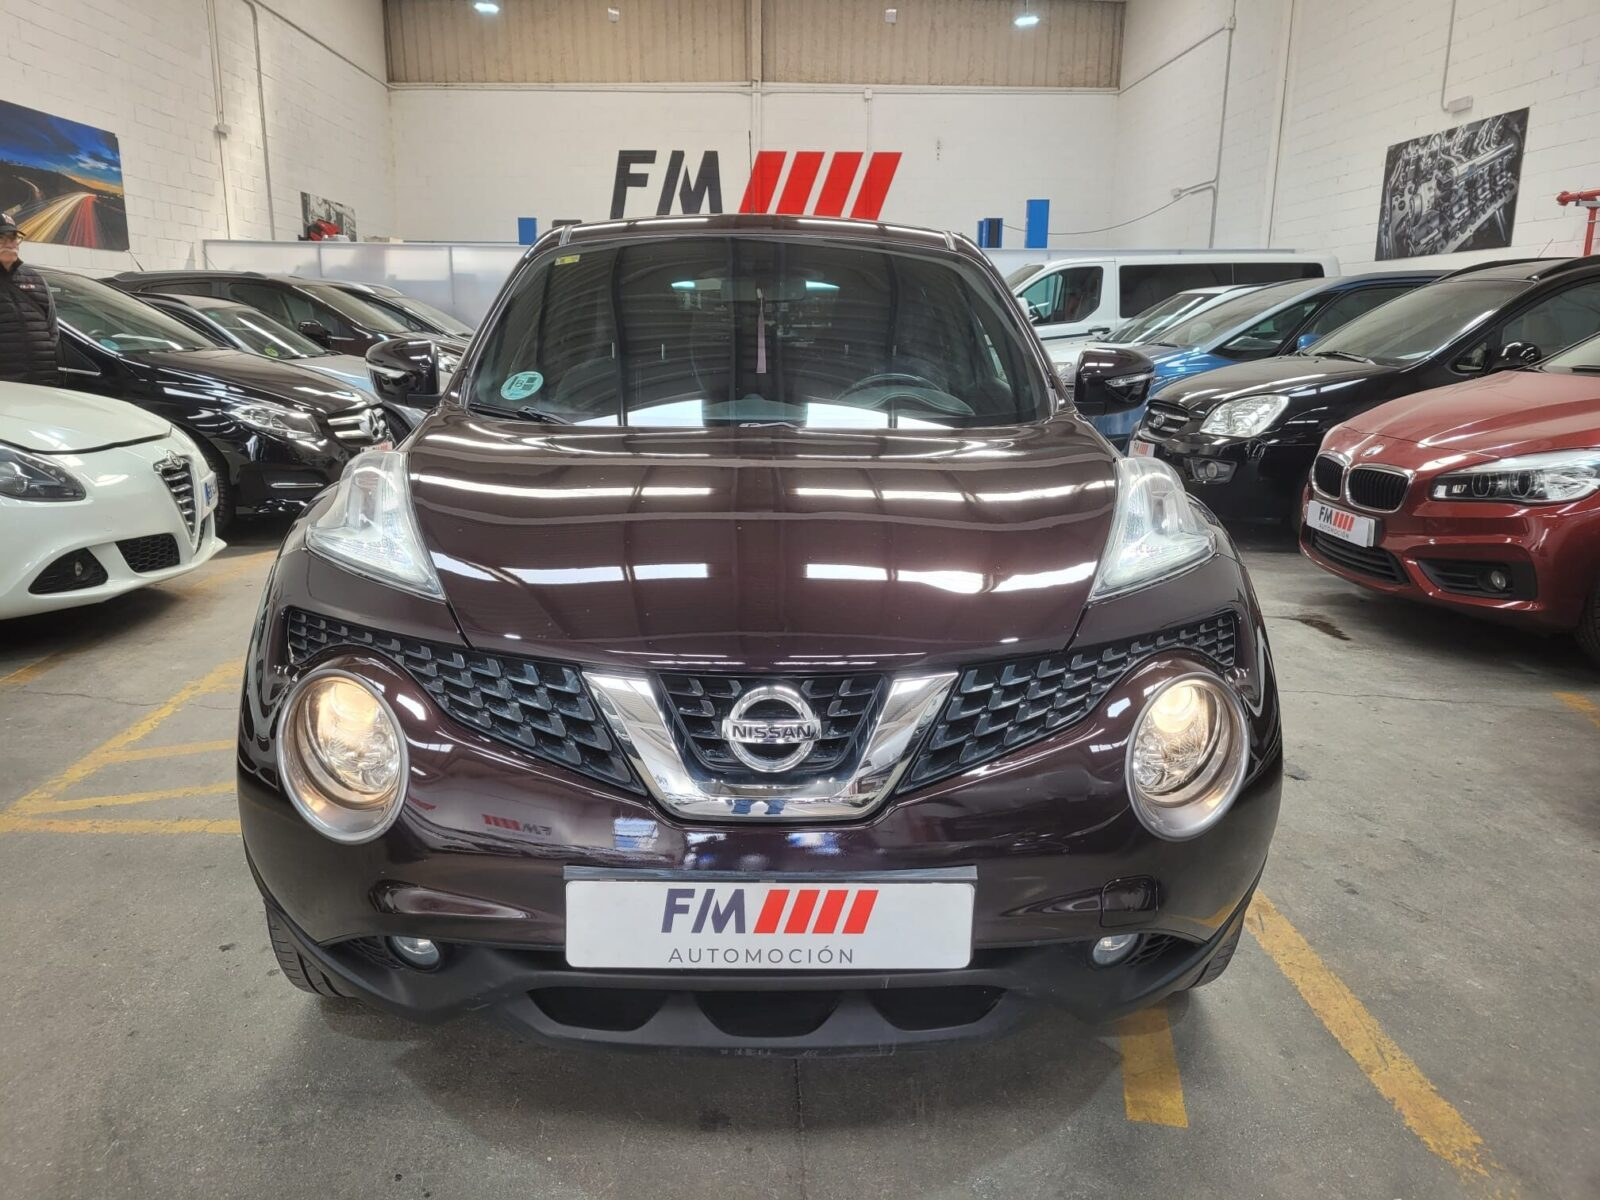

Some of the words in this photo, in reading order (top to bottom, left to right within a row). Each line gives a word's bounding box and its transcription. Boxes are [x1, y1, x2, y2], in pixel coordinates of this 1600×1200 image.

[610, 150, 723, 219] FM
[1318, 506, 1333, 524] FM
[732, 725, 811, 739] NISSAN
[661, 888, 746, 934] FM
[668, 945, 853, 964] AUTOMOCIÓN
